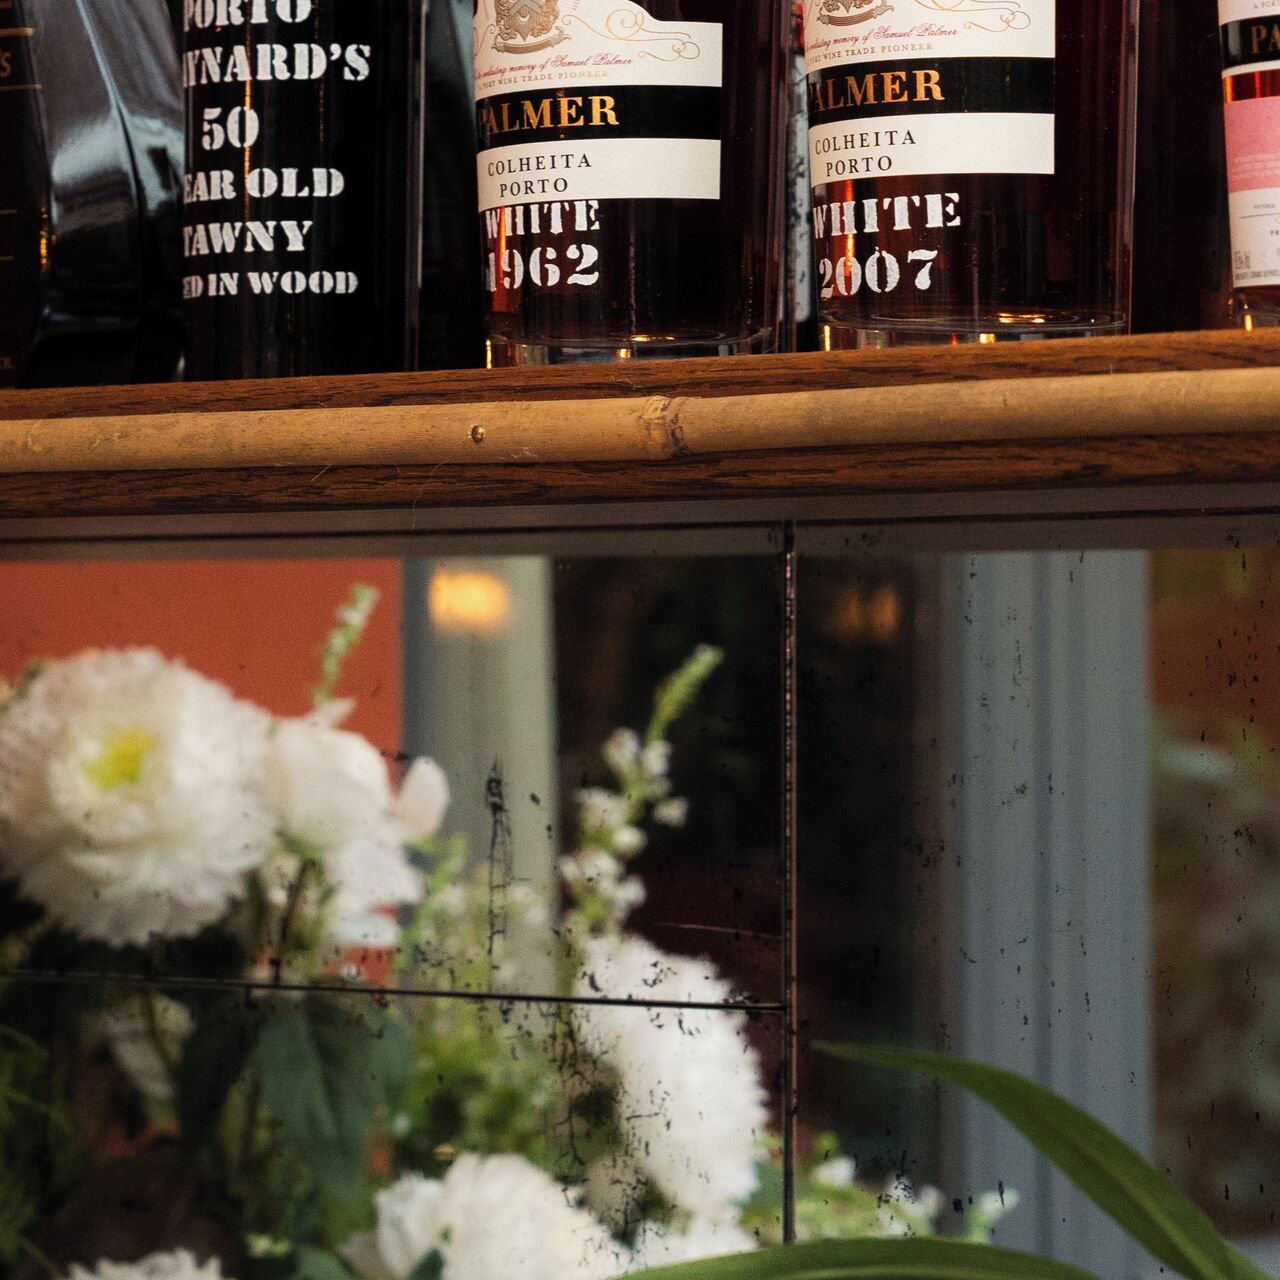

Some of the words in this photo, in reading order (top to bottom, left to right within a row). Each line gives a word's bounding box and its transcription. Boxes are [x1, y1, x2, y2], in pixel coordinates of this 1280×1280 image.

[873, 25, 914, 40] Samuel
[915, 22, 959, 37] Palmer
[508, 62, 537, 76] memory
[551, 54, 593, 68] Samuel
[593, 52, 634, 66] Palmer
[823, 51, 842, 61] WINE
[845, 46, 876, 57] TRADE
[880, 42, 934, 53] PIONEER
[498, 76, 518, 86] WINE
[522, 72, 554, 83] TRADE
[201, 105, 260, 150] 50
[815, 129, 917, 156] COLHEITA
[488, 153, 593, 177] COLHEITA
[826, 155, 893, 178] PORTO
[245, 167, 345, 198] OLD
[499, 177, 569, 198] PORTO
[485, 199, 601, 239] WHITE
[813, 192, 962, 239] WHITE
[183, 220, 313, 257] TAWNY
[486, 243, 600, 292] 1962
[819, 246, 938, 298] 2007
[208, 272, 239, 296] IN
[247, 271, 358, 295] WOOD
